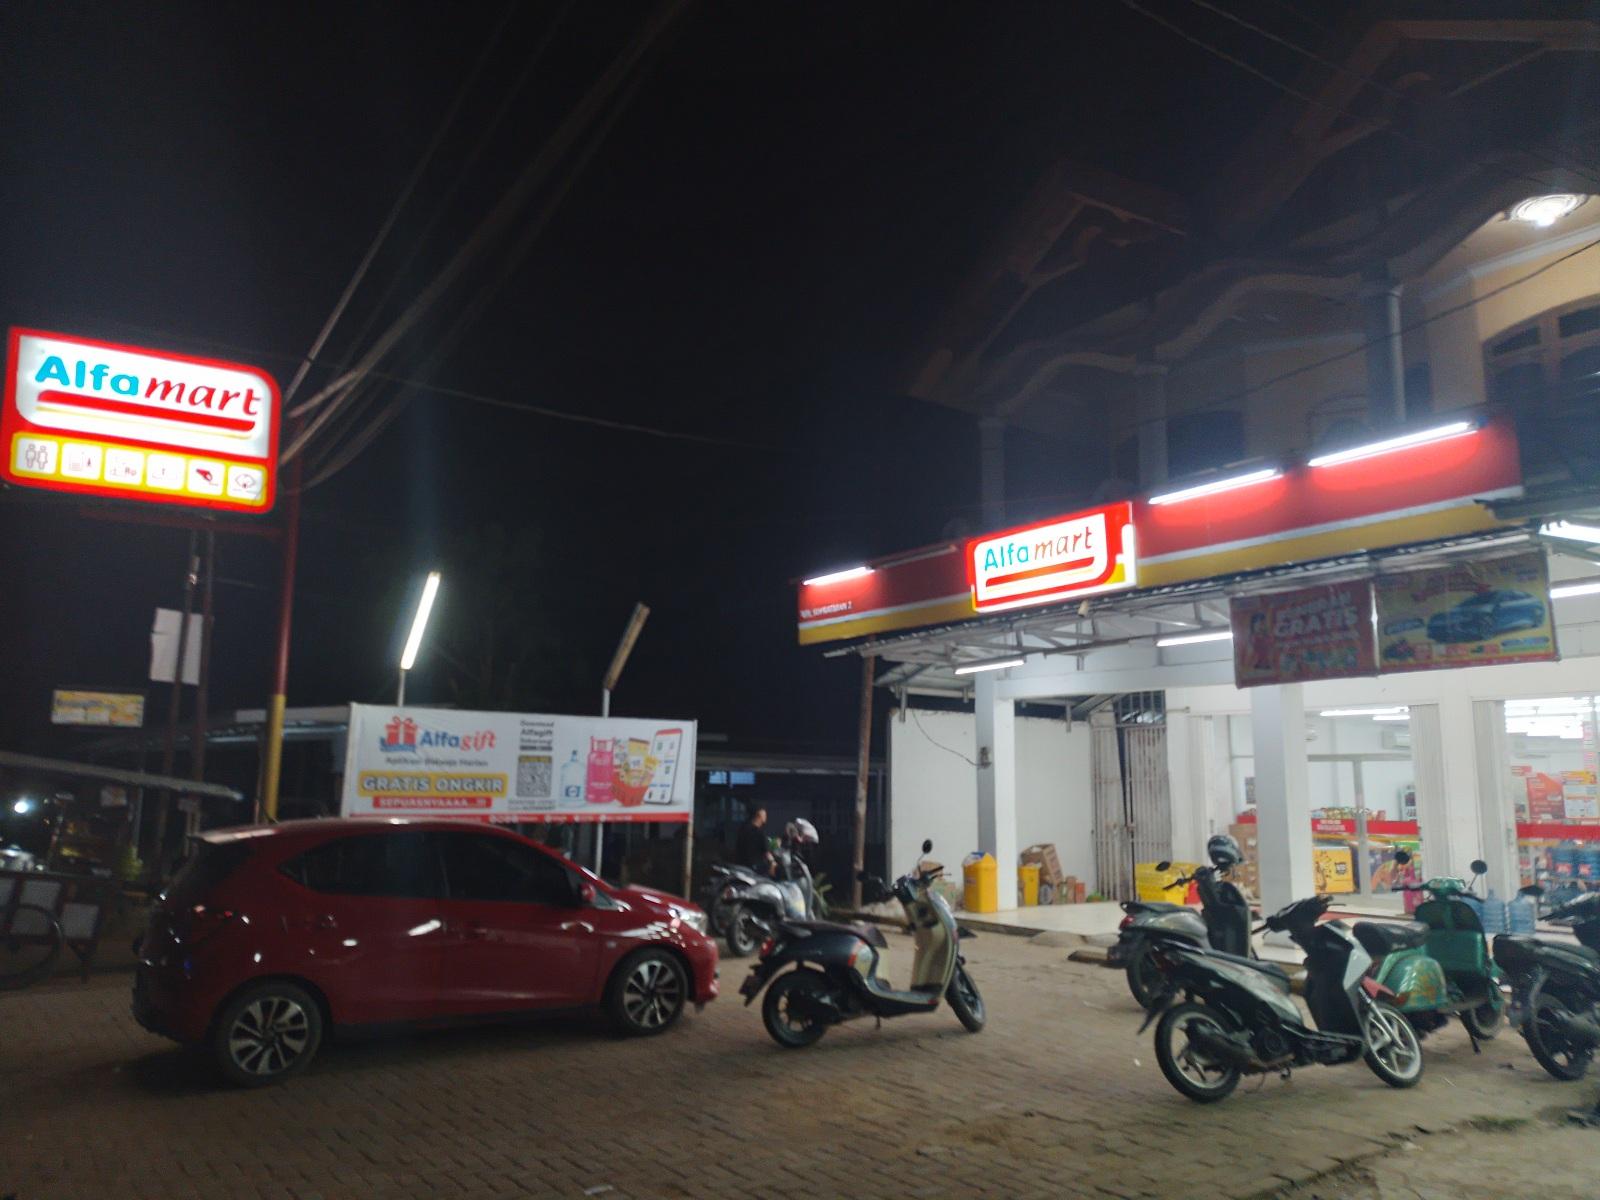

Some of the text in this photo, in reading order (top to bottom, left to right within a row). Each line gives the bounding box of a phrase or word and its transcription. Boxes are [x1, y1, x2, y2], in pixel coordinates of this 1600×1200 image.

[35, 355, 262, 416] Alfamart
[984, 525, 1093, 572] Alfamart
[419, 729, 498, 751] Alfagift
[363, 776, 503, 793] GRATIS ONGKIR
